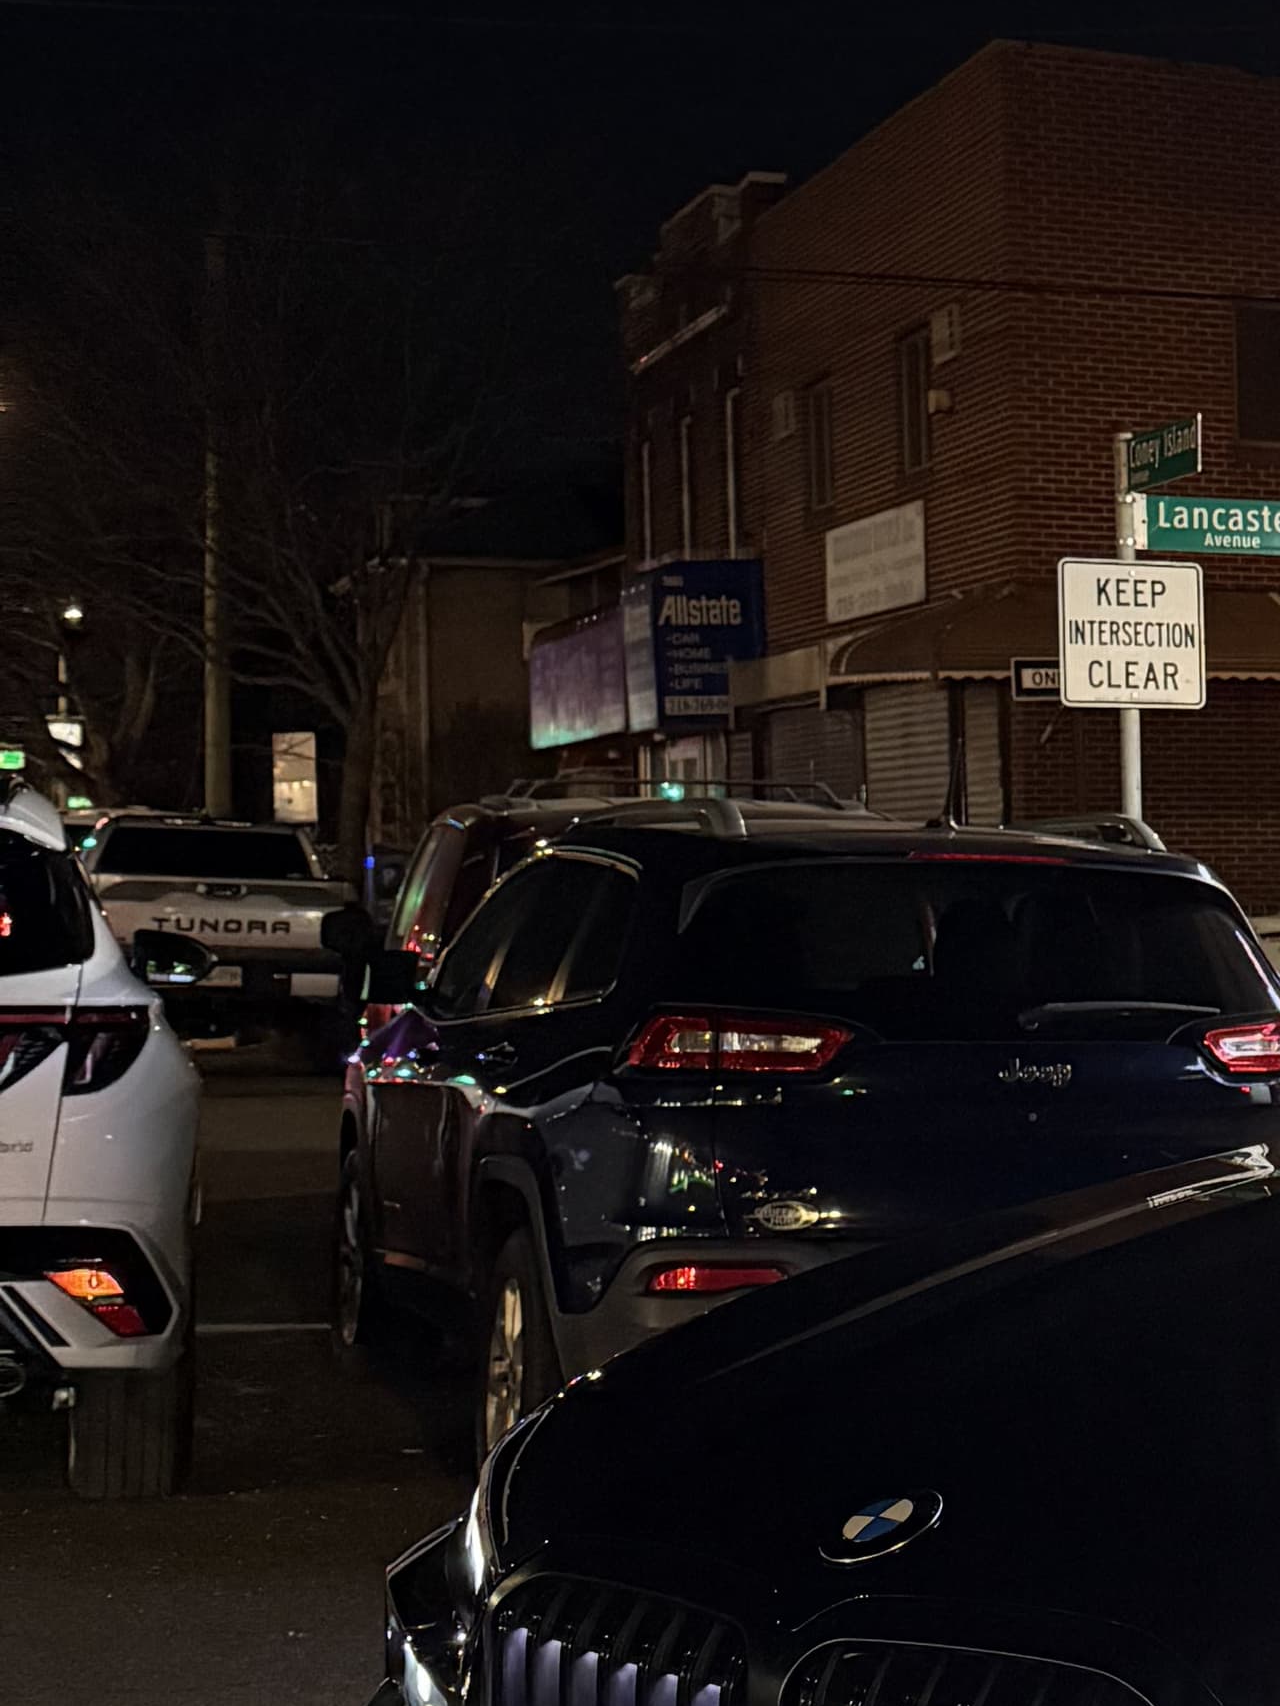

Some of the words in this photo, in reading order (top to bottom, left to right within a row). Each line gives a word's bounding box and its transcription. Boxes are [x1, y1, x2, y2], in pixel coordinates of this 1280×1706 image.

[1163, 418, 1197, 458] Island
[1204, 533, 1261, 549] Avenue
[1096, 577, 1167, 609] KEEP
[658, 593, 742, 626] Allstate
[1068, 619, 1196, 649] INTERSECTION
[1032, 671, 1060, 687] ON
[1088, 660, 1178, 690] CLEAR
[152, 917, 291, 934] TUNDRA
[998, 1057, 1072, 1089] Jeep
